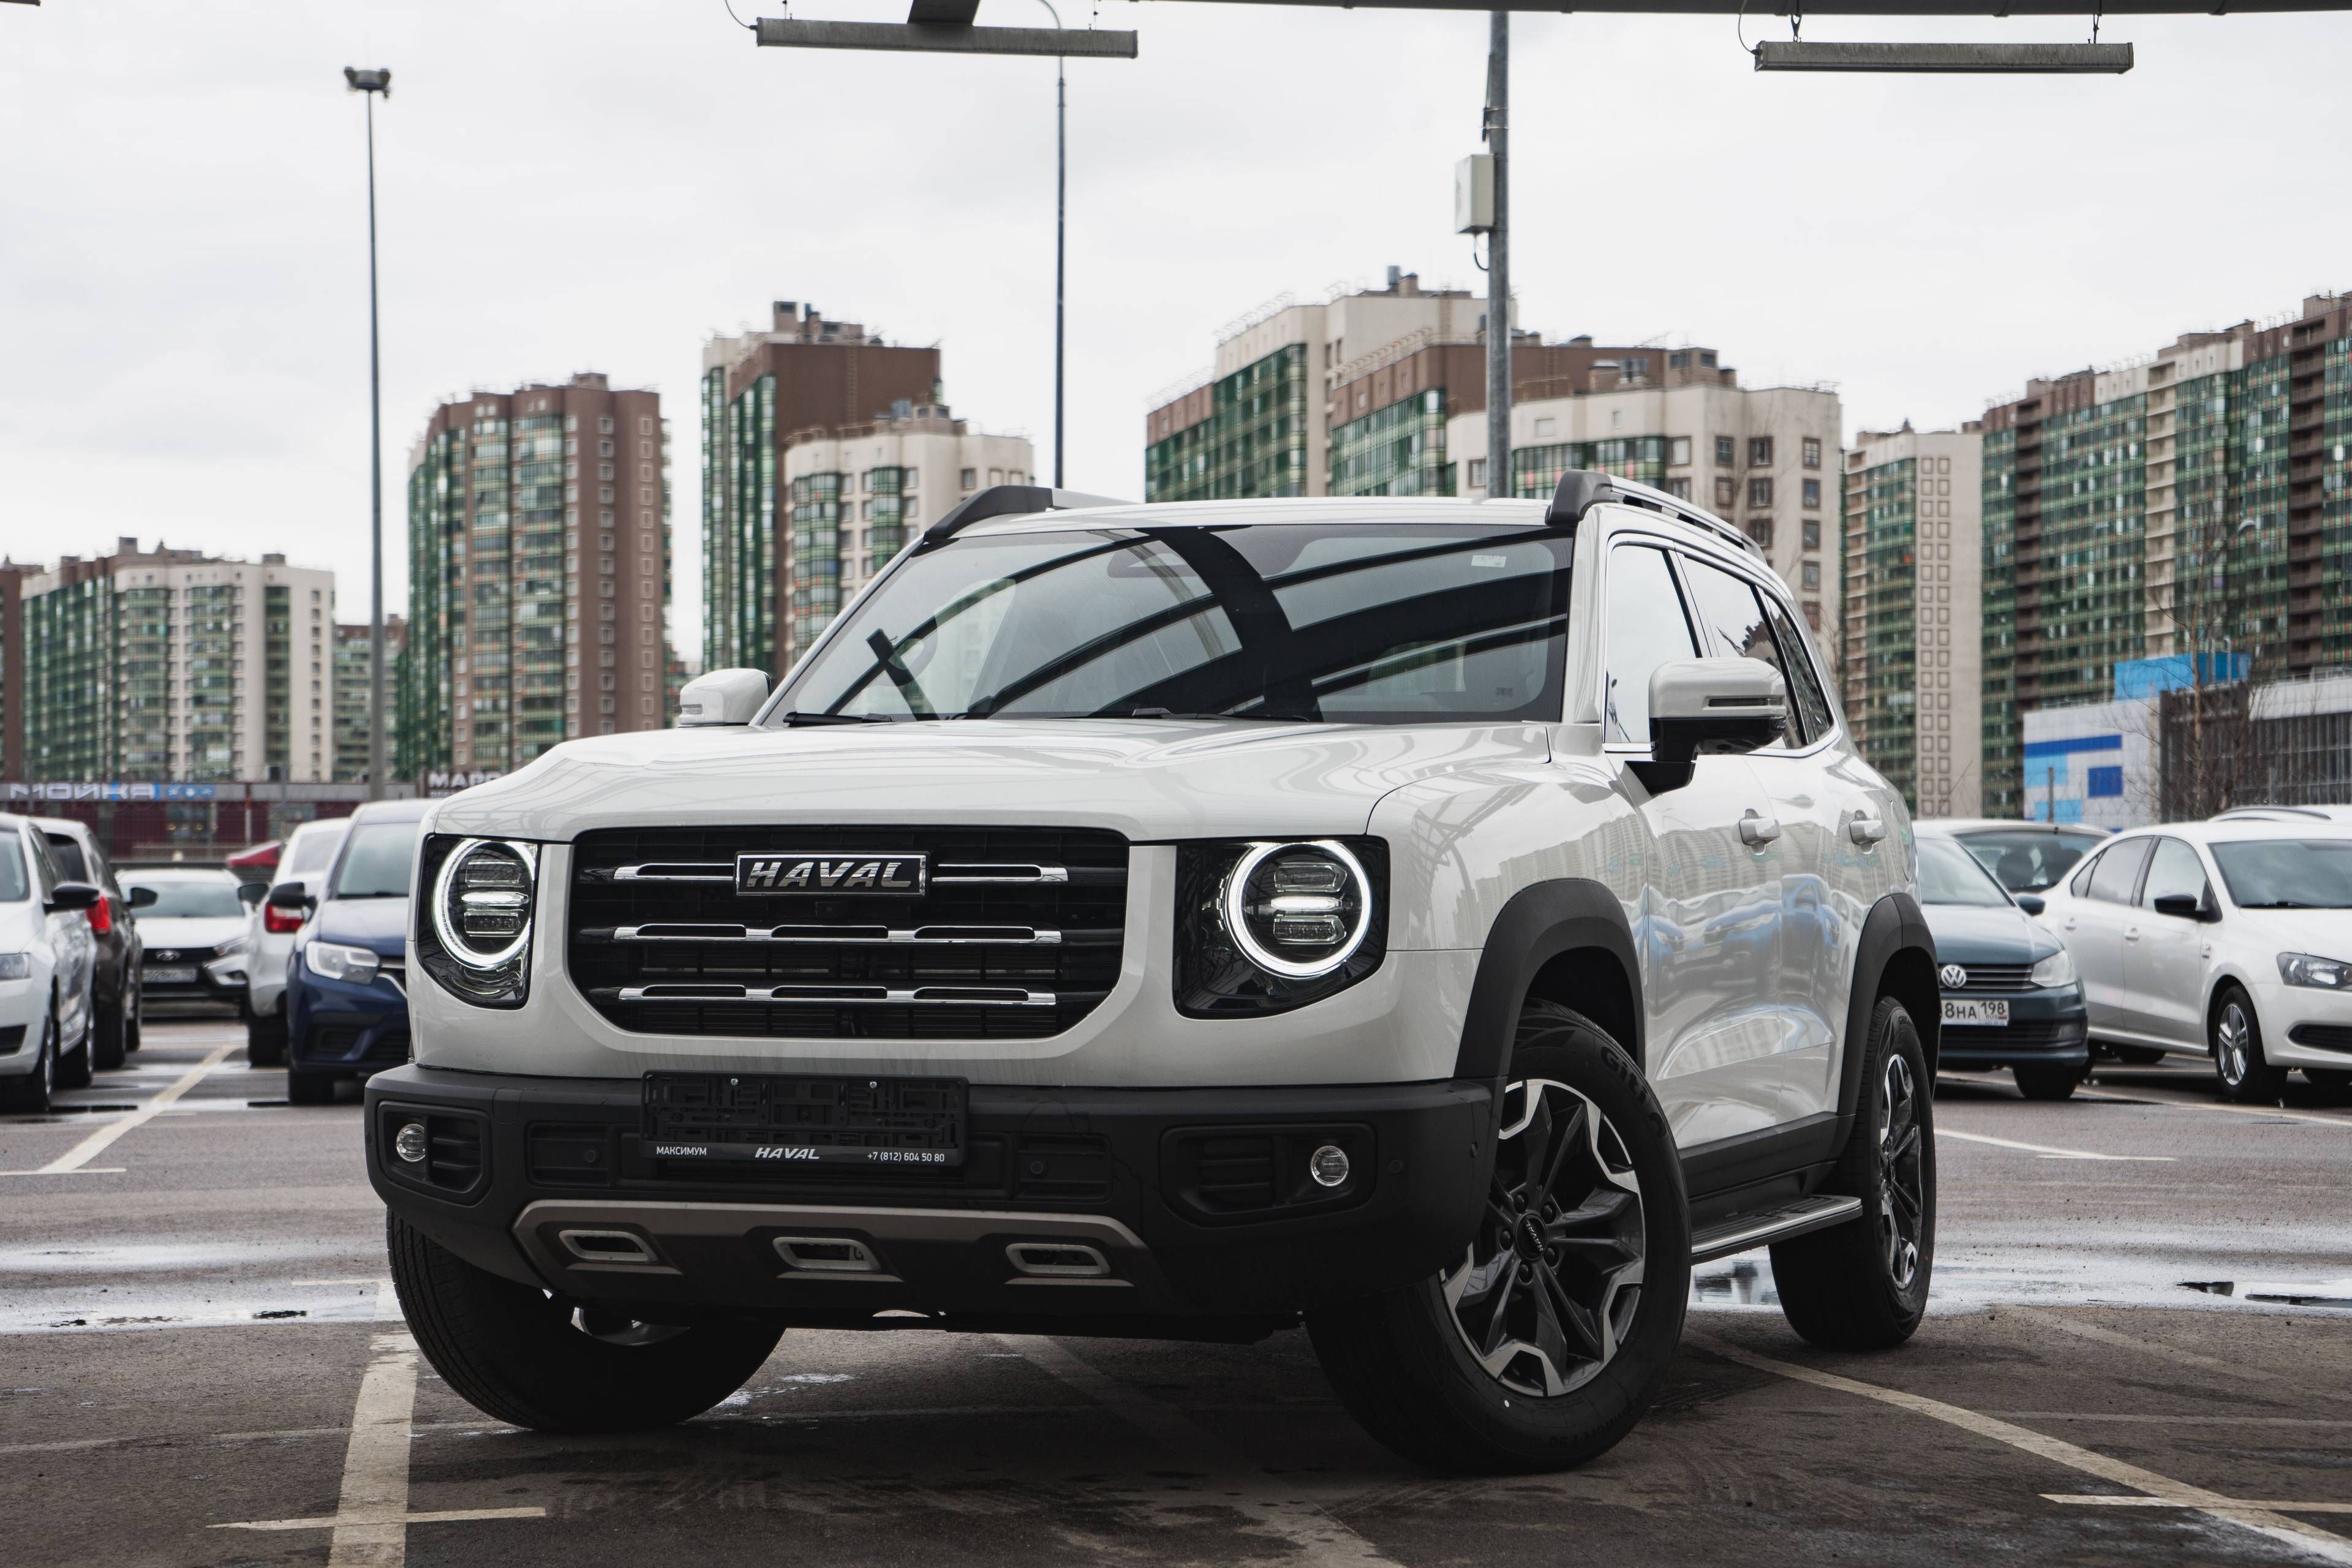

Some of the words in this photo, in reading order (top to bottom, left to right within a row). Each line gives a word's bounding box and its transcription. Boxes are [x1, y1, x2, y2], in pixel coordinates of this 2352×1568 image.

[10, 782, 154, 799] МОЙКА
[746, 862, 912, 888] HAVAL
[1980, 1001, 2005, 1015] 198
[1601, 1047, 1648, 1104] Giti
[656, 1146, 707, 1156] МАКСИМУМ
[755, 1147, 820, 1159] HAVAL
[880, 1152, 902, 1161] (812)
[934, 1153, 945, 1162] 80
